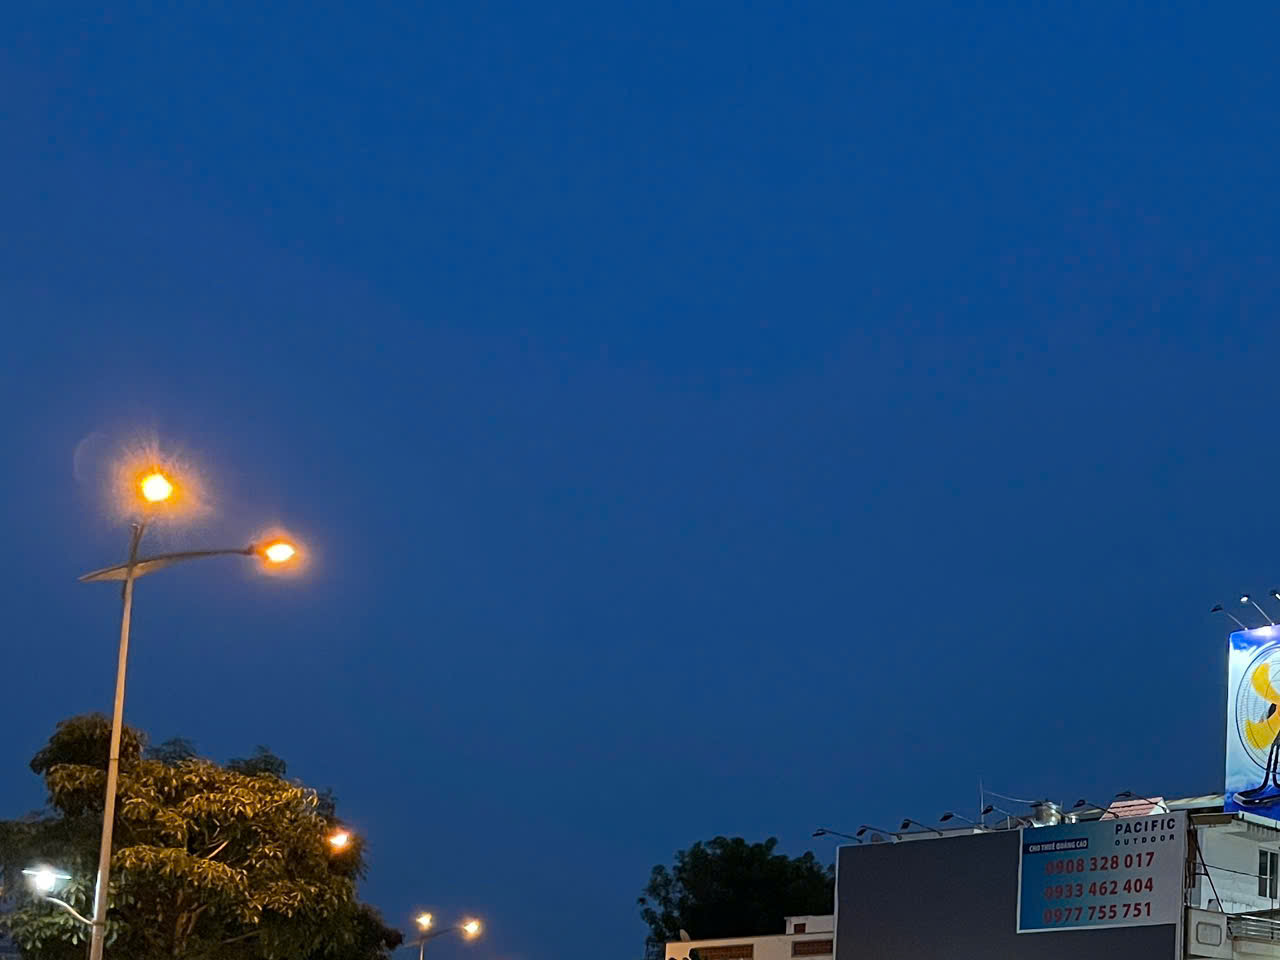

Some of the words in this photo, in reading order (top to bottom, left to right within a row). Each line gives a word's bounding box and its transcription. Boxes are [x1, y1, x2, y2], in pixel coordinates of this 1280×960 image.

[1115, 818, 1176, 835] PACIFIC
[1028, 843, 1040, 852] CHO
[1114, 834, 1175, 847] OUTDOOR
[1045, 858, 1085, 875] 0908
[1089, 855, 1119, 872] 328
[1124, 852, 1155, 868] 017
[1044, 884, 1084, 899] 0933
[1088, 881, 1118, 897] 462
[1123, 877, 1153, 893] 404
[1043, 907, 1083, 924] 0977
[1088, 904, 1117, 920] 755
[1122, 902, 1152, 918] 751
